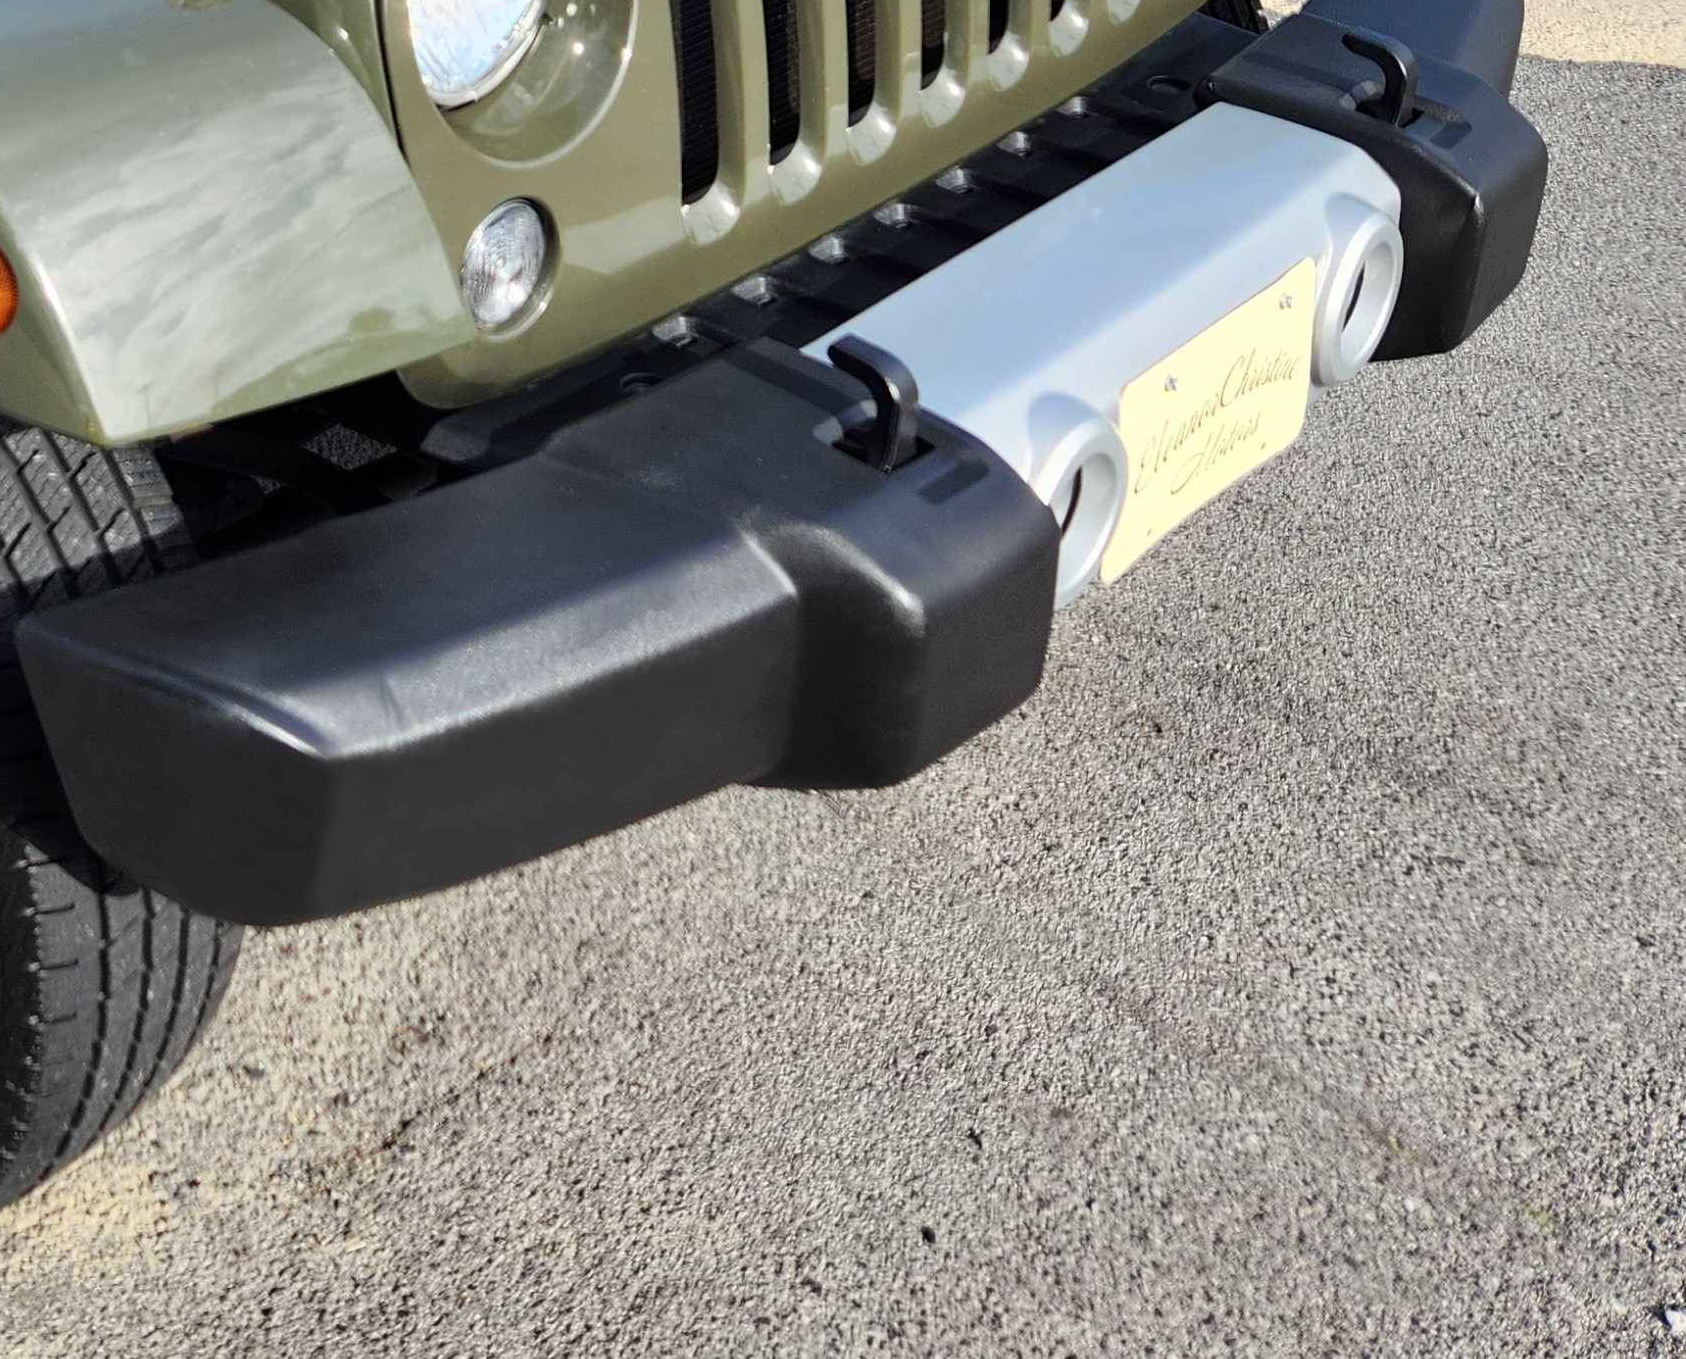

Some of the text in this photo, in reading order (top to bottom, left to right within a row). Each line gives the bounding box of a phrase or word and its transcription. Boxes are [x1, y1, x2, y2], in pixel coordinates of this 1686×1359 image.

[1134, 348, 1300, 494] Eleanor Christine
[1170, 410, 1261, 495] Motors
